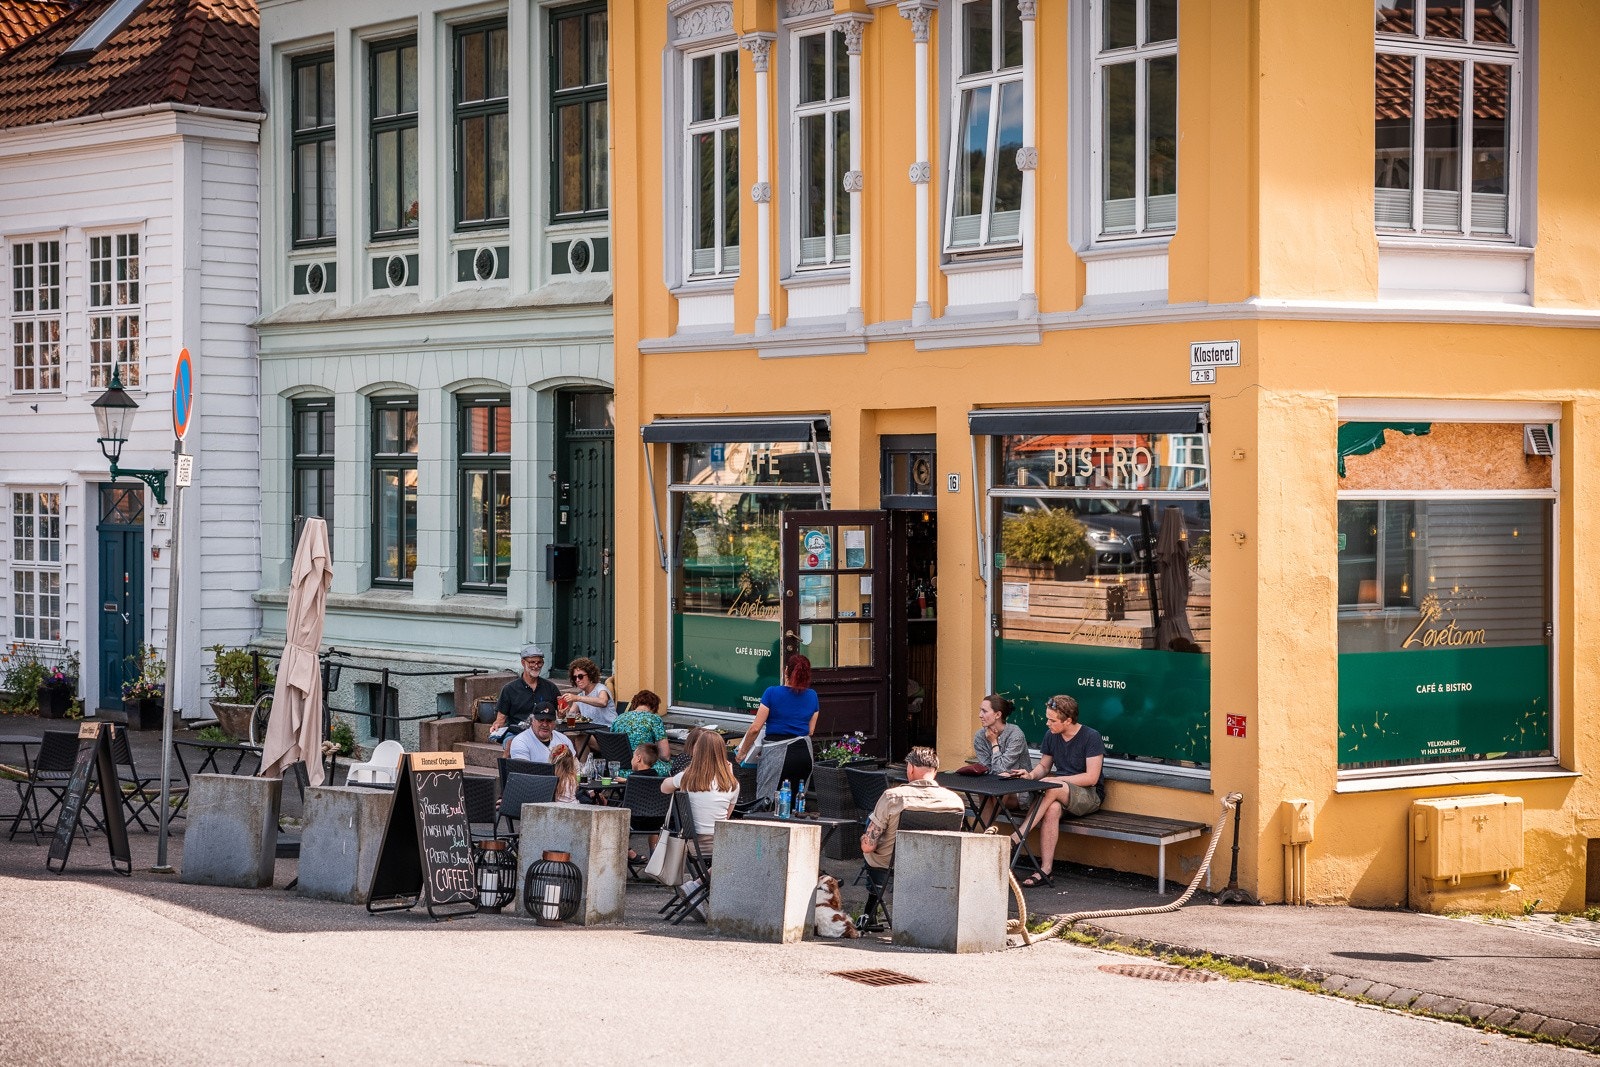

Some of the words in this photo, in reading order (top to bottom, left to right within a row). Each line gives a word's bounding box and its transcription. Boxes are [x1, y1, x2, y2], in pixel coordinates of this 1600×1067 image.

[1194, 346, 1233, 362] Klosteret
[1195, 370, 1210, 380] 2-16
[1054, 446, 1152, 478] BISTRO
[950, 475, 957, 489] 16
[735, 646, 748, 655] CAFÉ
[748, 648, 753, 656] &
[753, 648, 772, 657] BISTRO
[1077, 677, 1095, 687] CAFÉ
[1096, 679, 1101, 687] &
[1102, 680, 1126, 689] BISTRO
[1416, 682, 1436, 693] CAFÉ
[1437, 684, 1443, 692] &
[1445, 683, 1472, 692] BISTRO
[1427, 739, 1460, 747] VELKOMMEN
[1439, 746, 1466, 754] TAKE-AWAY
[421, 757, 438, 766] Honest
[438, 757, 457, 766] Organic
[435, 868, 472, 892] COFFEE
